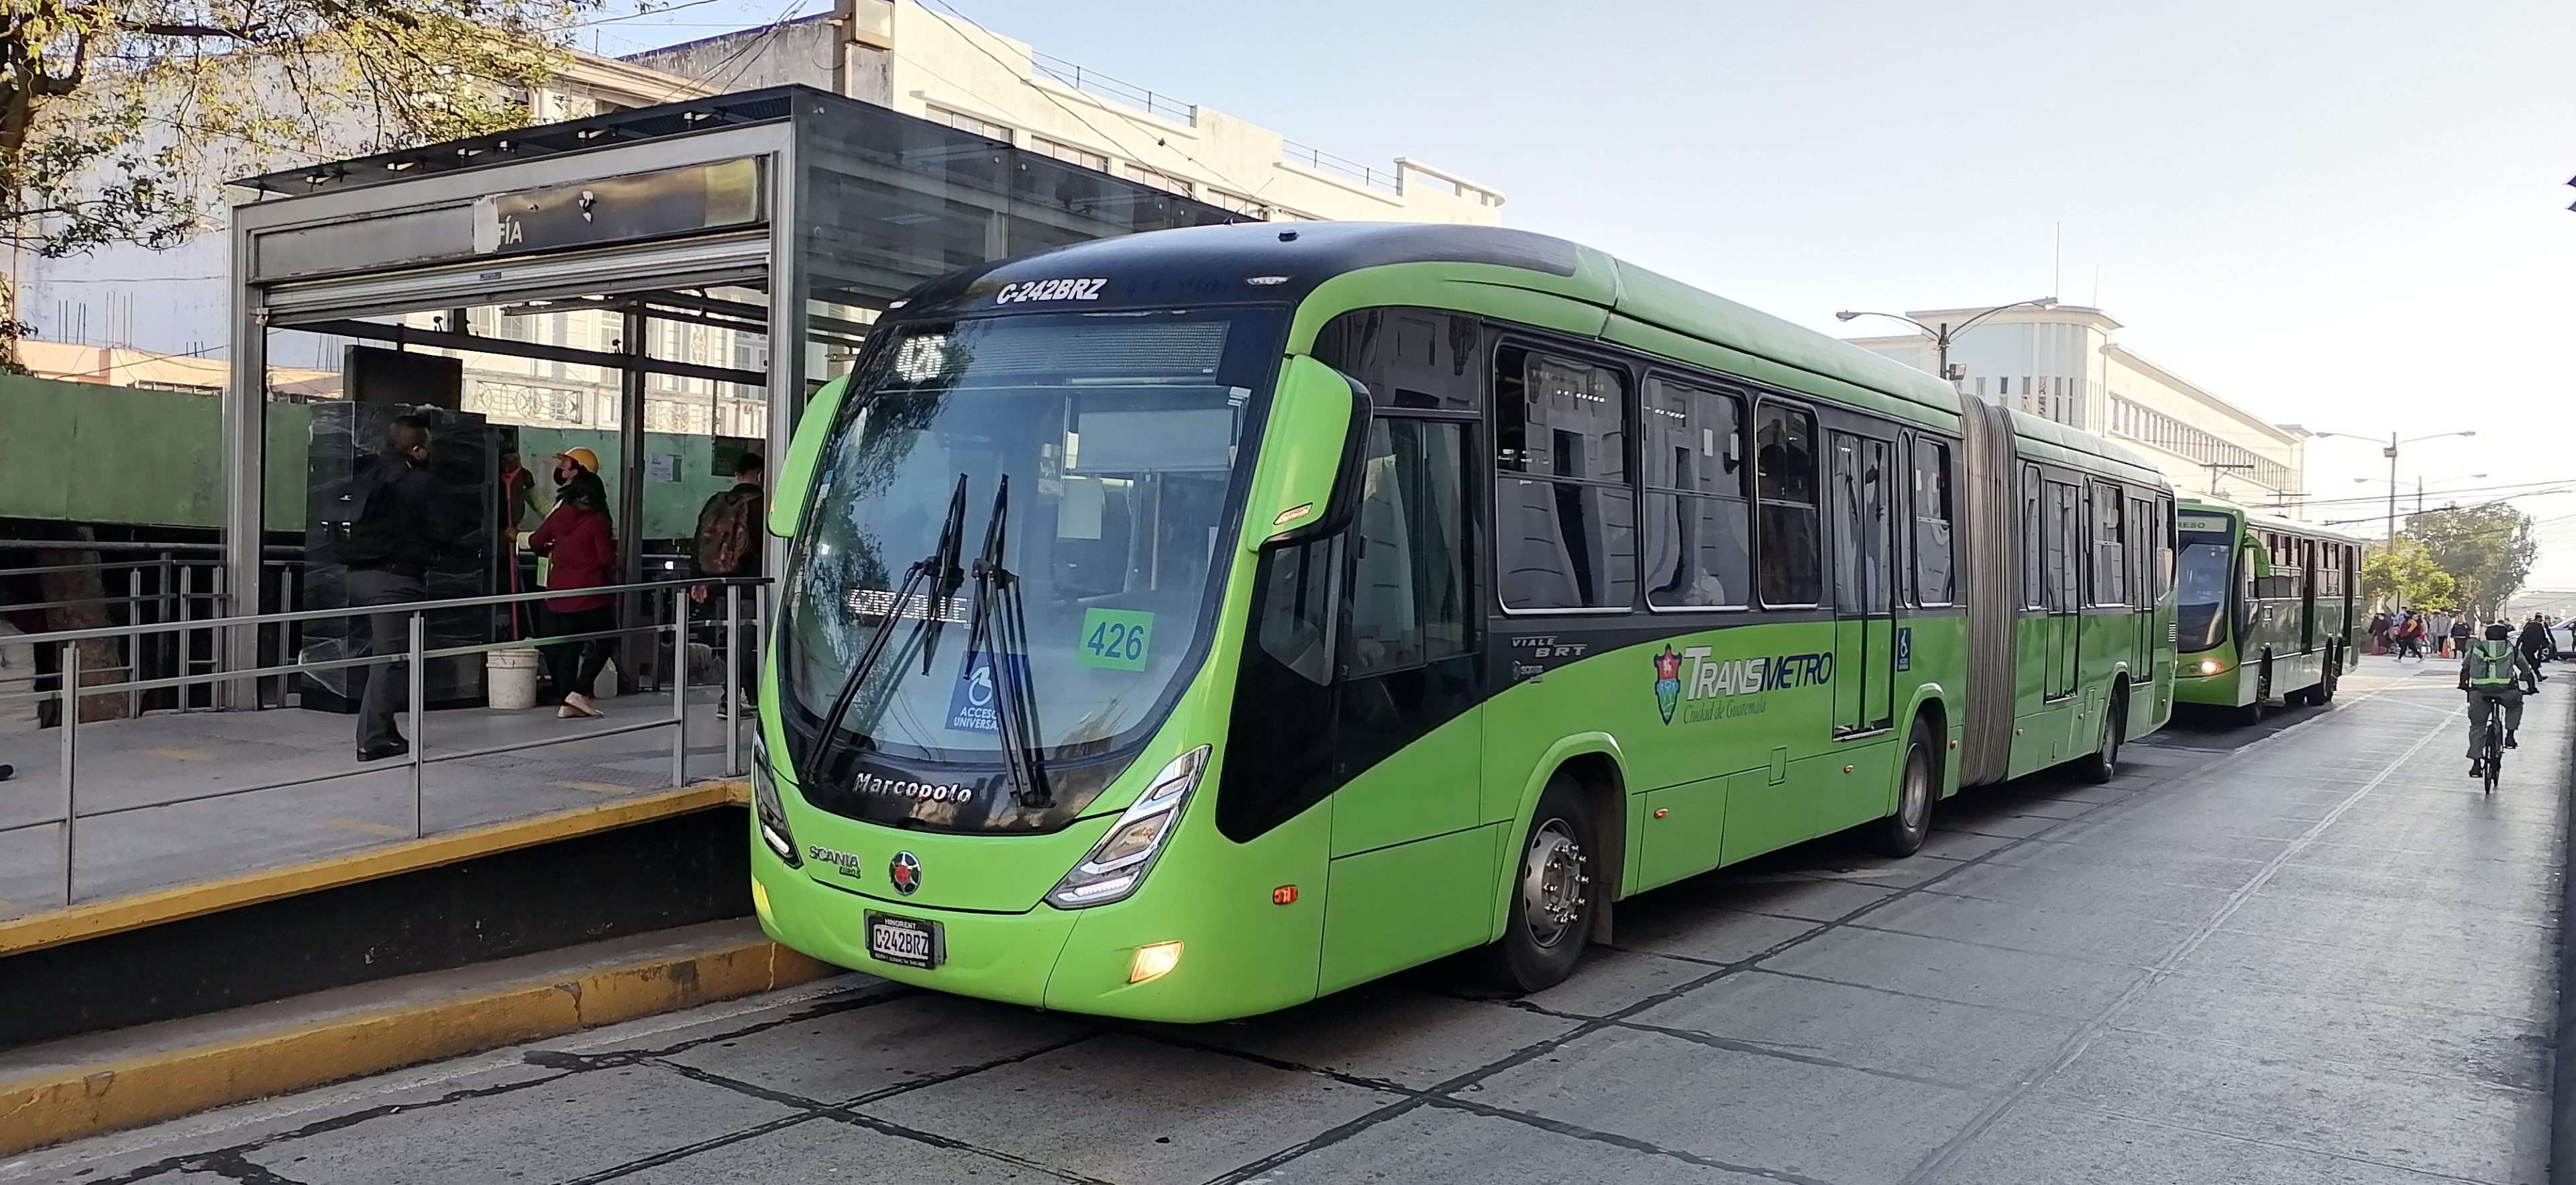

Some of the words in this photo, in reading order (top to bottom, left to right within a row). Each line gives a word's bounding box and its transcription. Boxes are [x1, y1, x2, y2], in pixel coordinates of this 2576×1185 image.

[997, 278, 1107, 304] C-242BRZ
[896, 335, 946, 380] 426
[1087, 621, 1144, 660] 426
[1512, 638, 1555, 647] VIALE
[1535, 647, 1586, 658] BRT
[1683, 703, 1712, 724] Ciudad
[1714, 701, 1724, 720] de
[1726, 697, 1766, 719] Guatemala
[954, 717, 999, 731] UNIVERSA
[853, 772, 972, 803] Marcopolo
[809, 845, 859, 870] SCANIA
[885, 918, 916, 930] HINORENT
